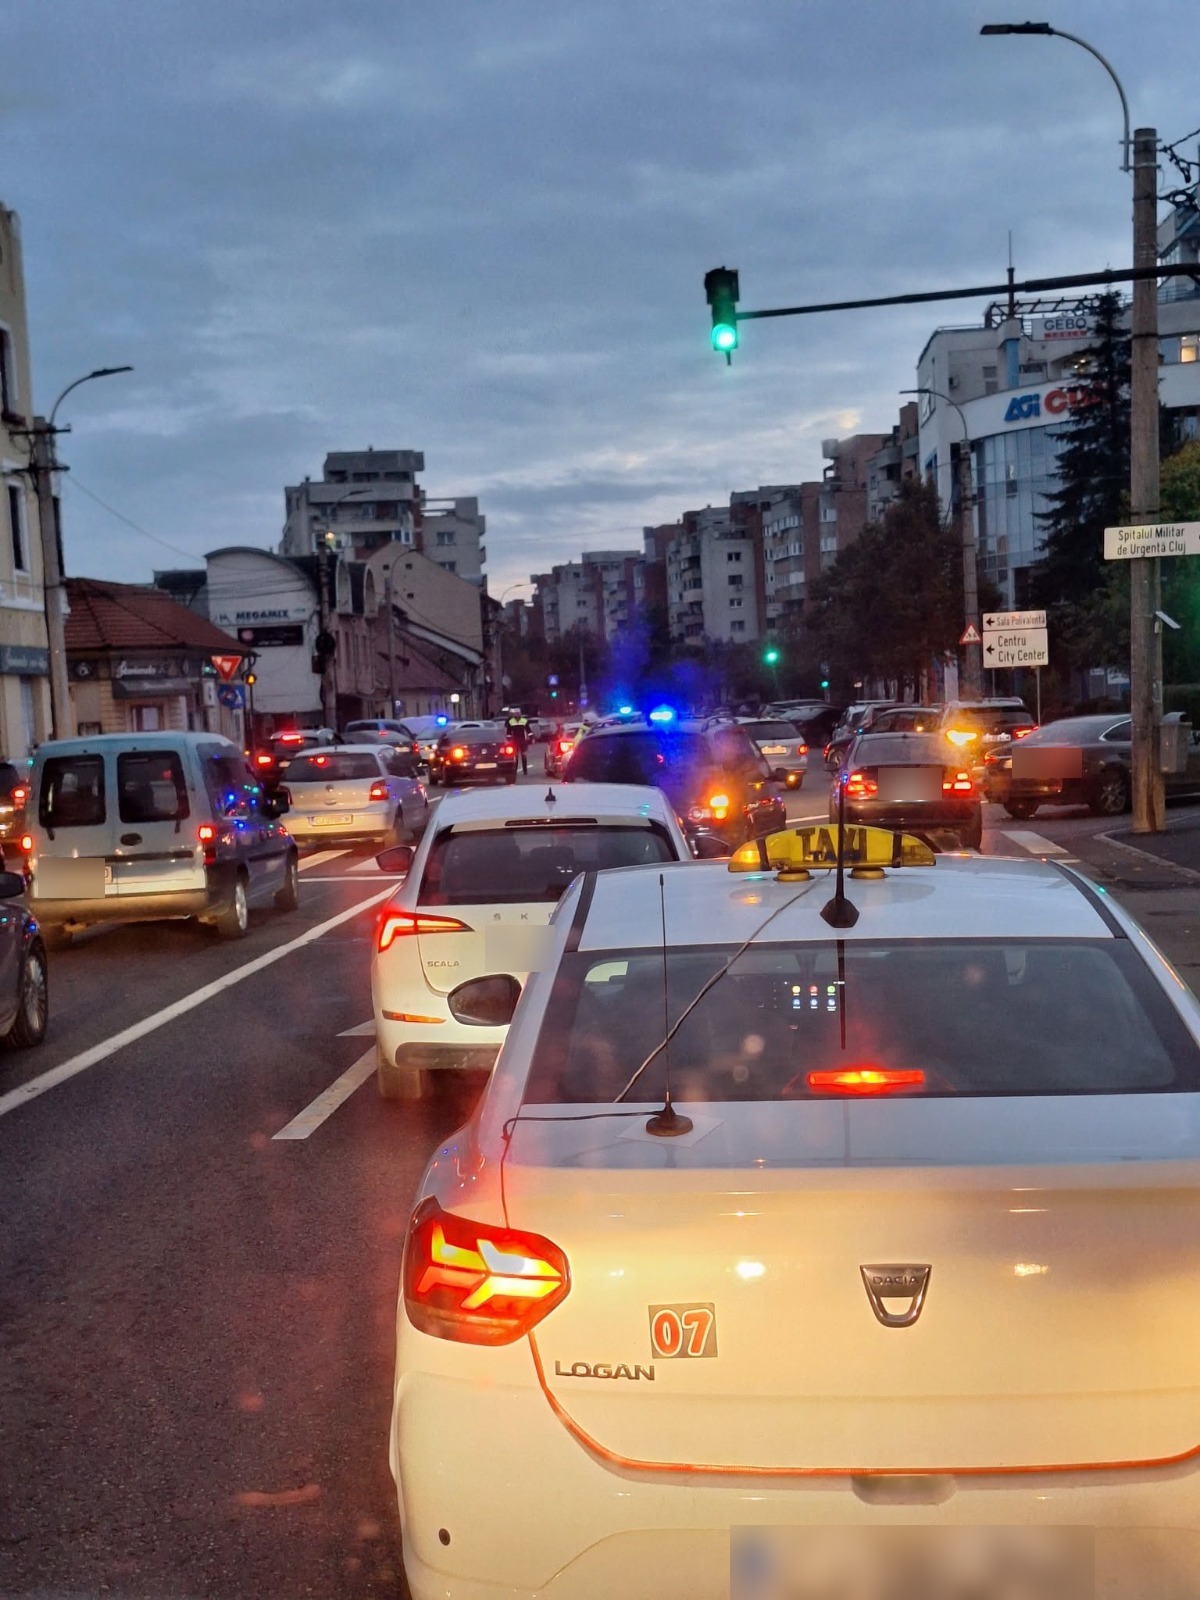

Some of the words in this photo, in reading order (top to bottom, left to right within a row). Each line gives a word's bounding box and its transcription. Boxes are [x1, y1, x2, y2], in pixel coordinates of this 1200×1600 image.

[1043, 318, 1087, 331] GEBO
[1118, 527, 1152, 543] Spitalul
[1155, 526, 1185, 538] Militar
[1117, 545, 1128, 556] de
[1168, 540, 1186, 555] Cluj
[235, 609, 289, 620] MEGAMIX
[996, 616, 1010, 627] Sala
[998, 635, 1027, 648] Centru
[998, 650, 1015, 665] City
[1017, 649, 1046, 662] Center
[795, 827, 868, 862] TAXI
[426, 959, 460, 969] SCALA
[872, 1275, 920, 1285] DACIA
[651, 1308, 714, 1358] 07
[555, 1359, 656, 1382] LOGAN
